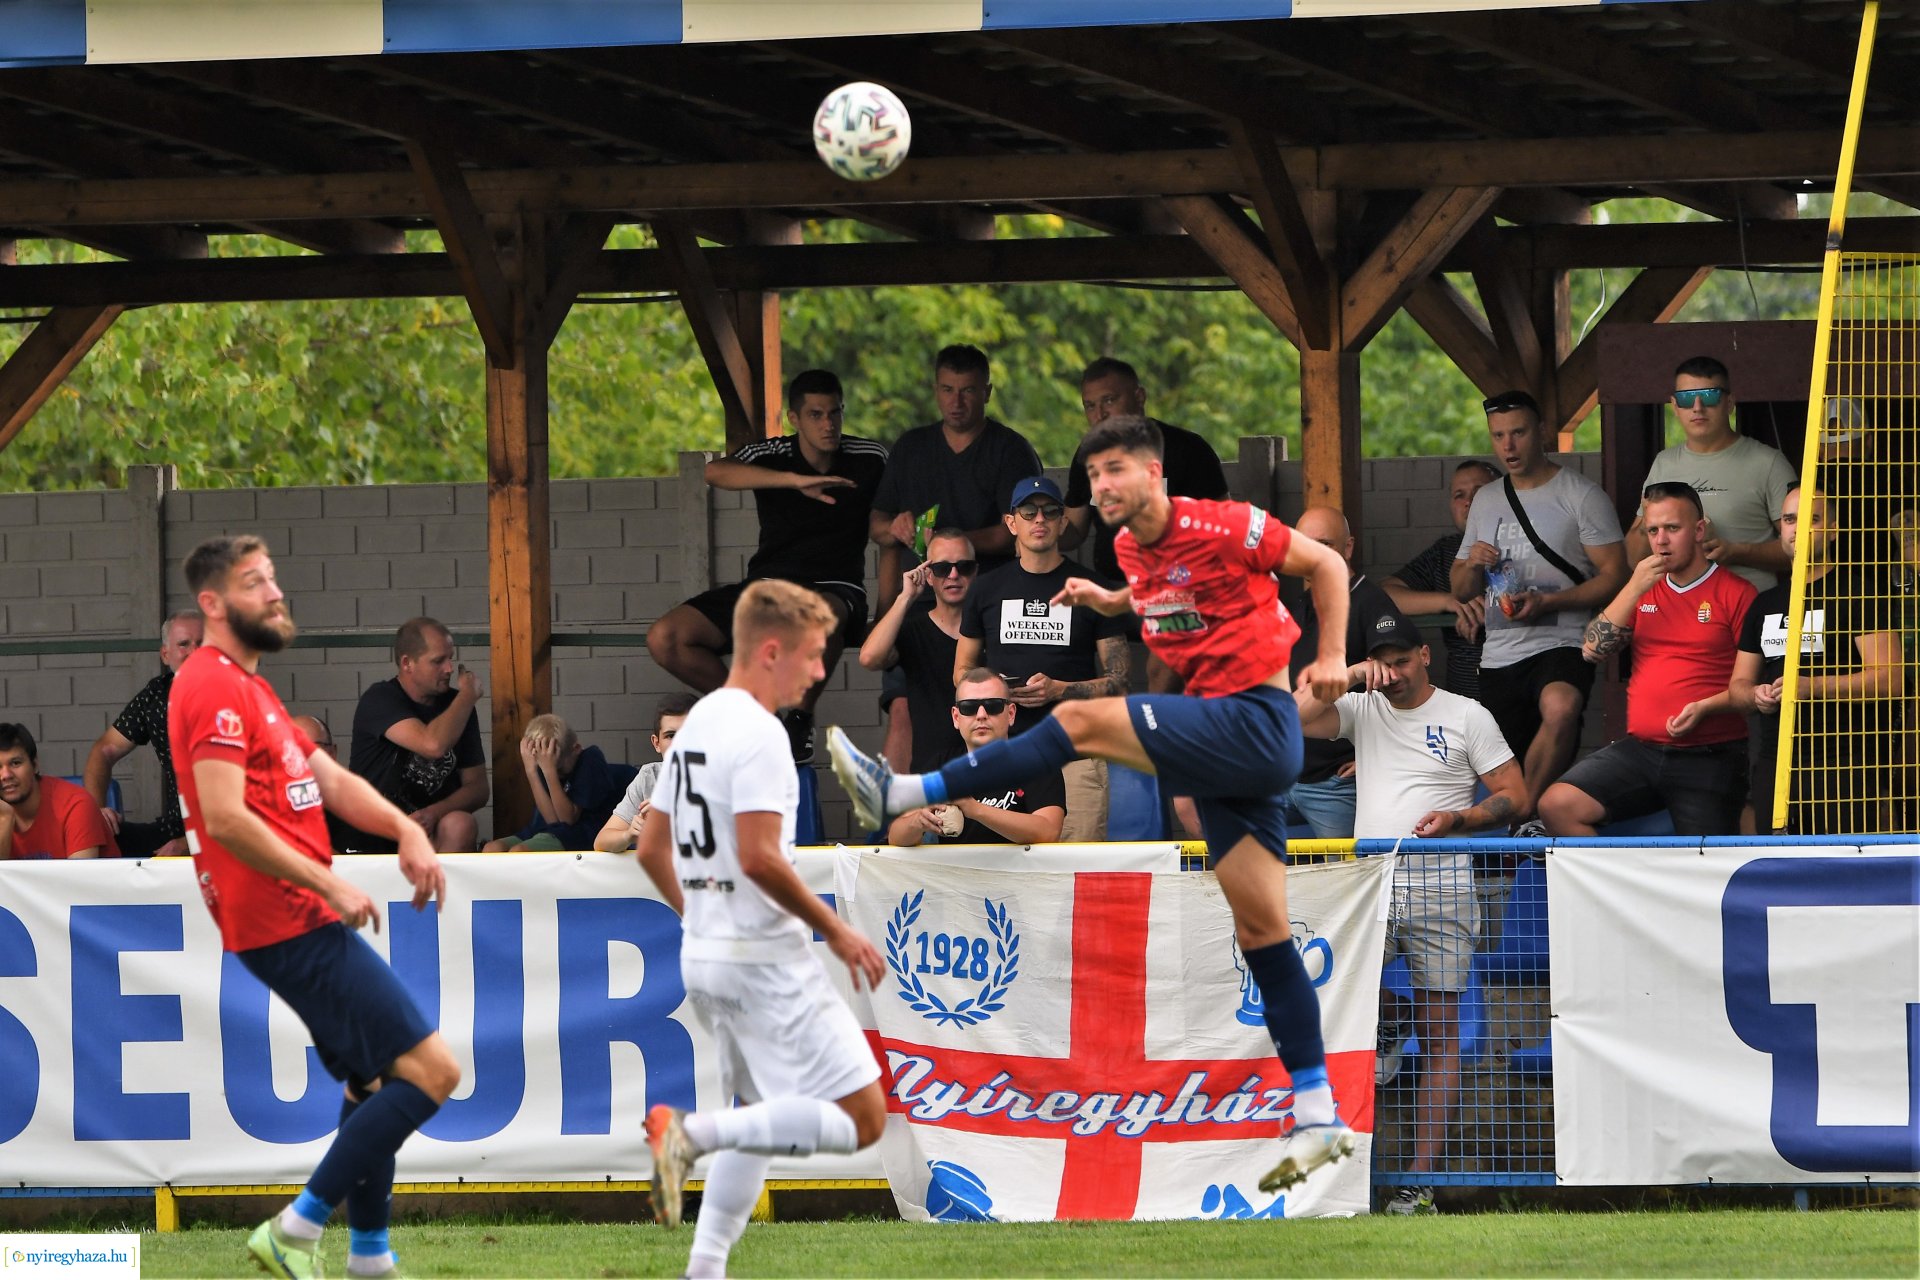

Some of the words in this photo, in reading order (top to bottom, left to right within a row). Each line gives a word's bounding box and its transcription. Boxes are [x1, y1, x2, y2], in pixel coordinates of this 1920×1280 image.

[1007, 621, 1064, 630] WEEKEND
[1376, 620, 1396, 629] GUCCI
[1004, 631, 1064, 641] OFFENDER
[916, 931, 990, 981] 1928
[885, 1048, 1338, 1138] Nyíregyház
